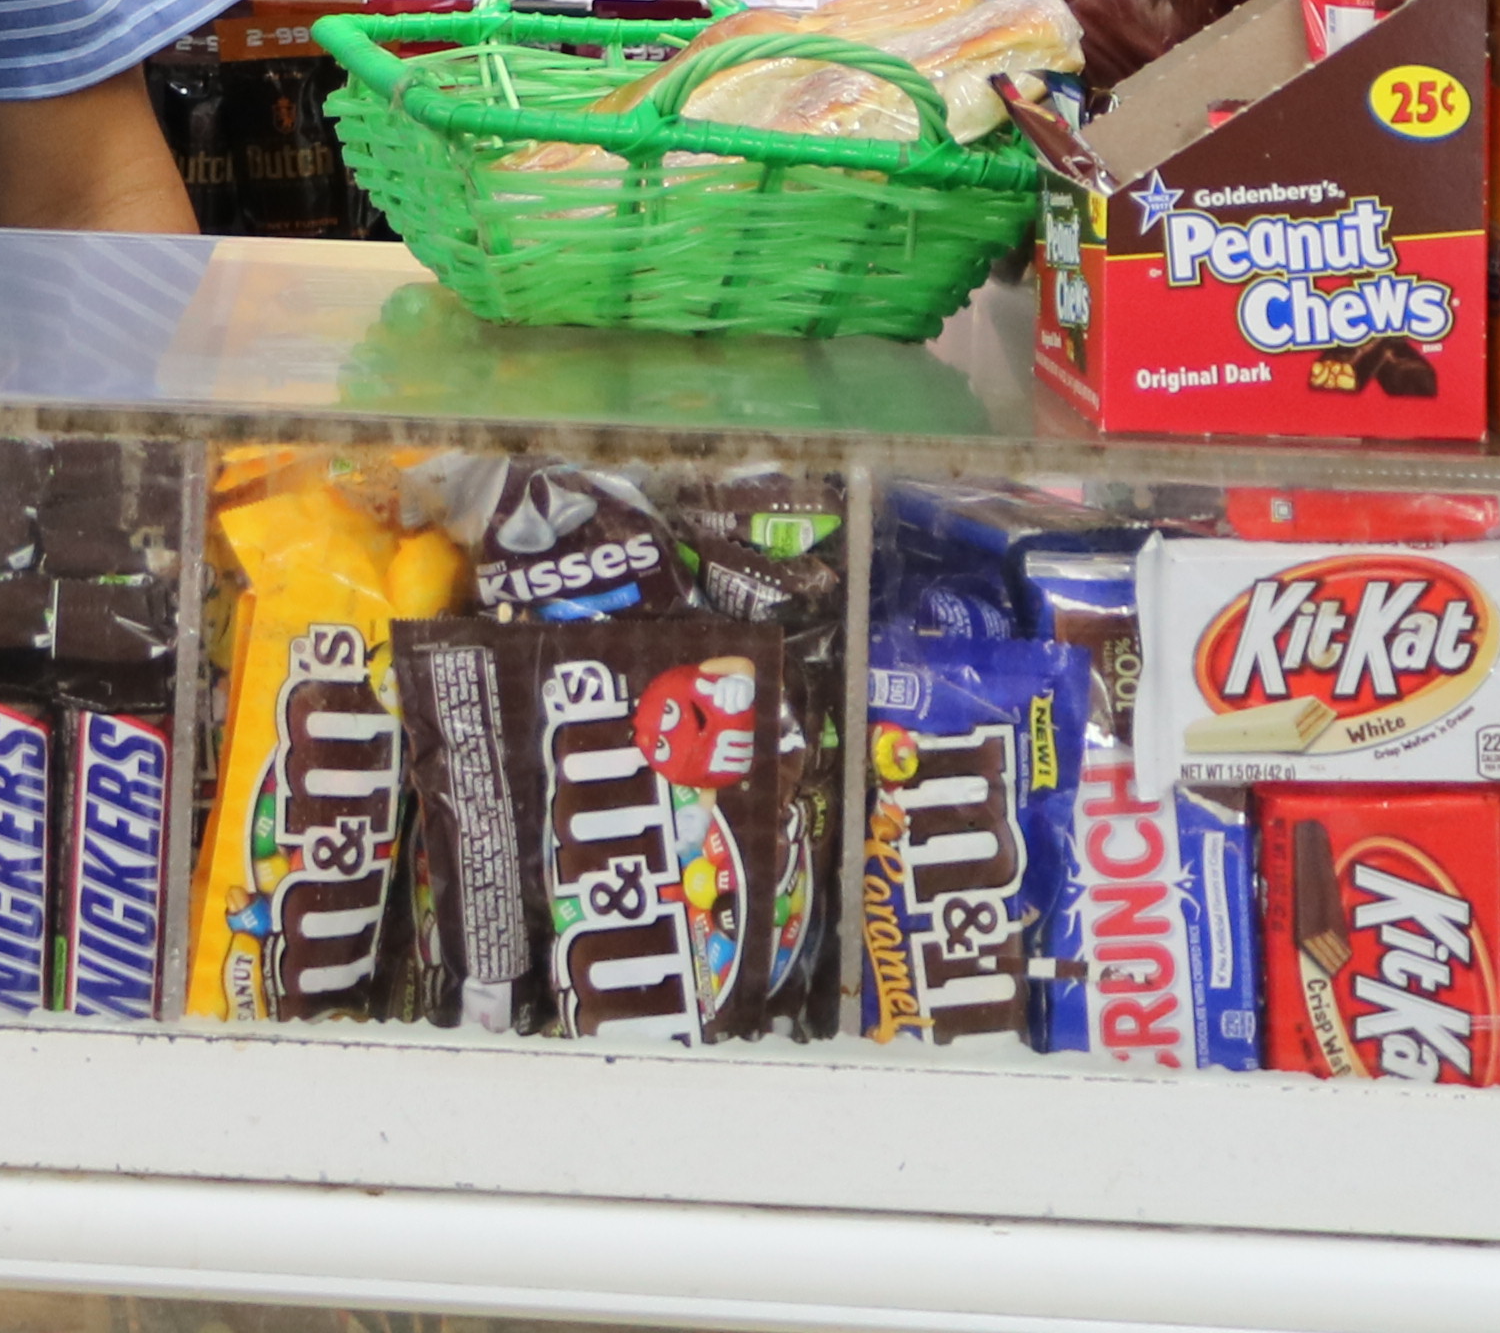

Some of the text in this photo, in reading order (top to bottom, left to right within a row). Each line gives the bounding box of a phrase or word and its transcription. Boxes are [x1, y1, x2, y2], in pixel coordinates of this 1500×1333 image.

[1194, 180, 1346, 207] Goldenberg's
[1167, 198, 1396, 285] Peanut
[1238, 276, 1452, 352] Chews
